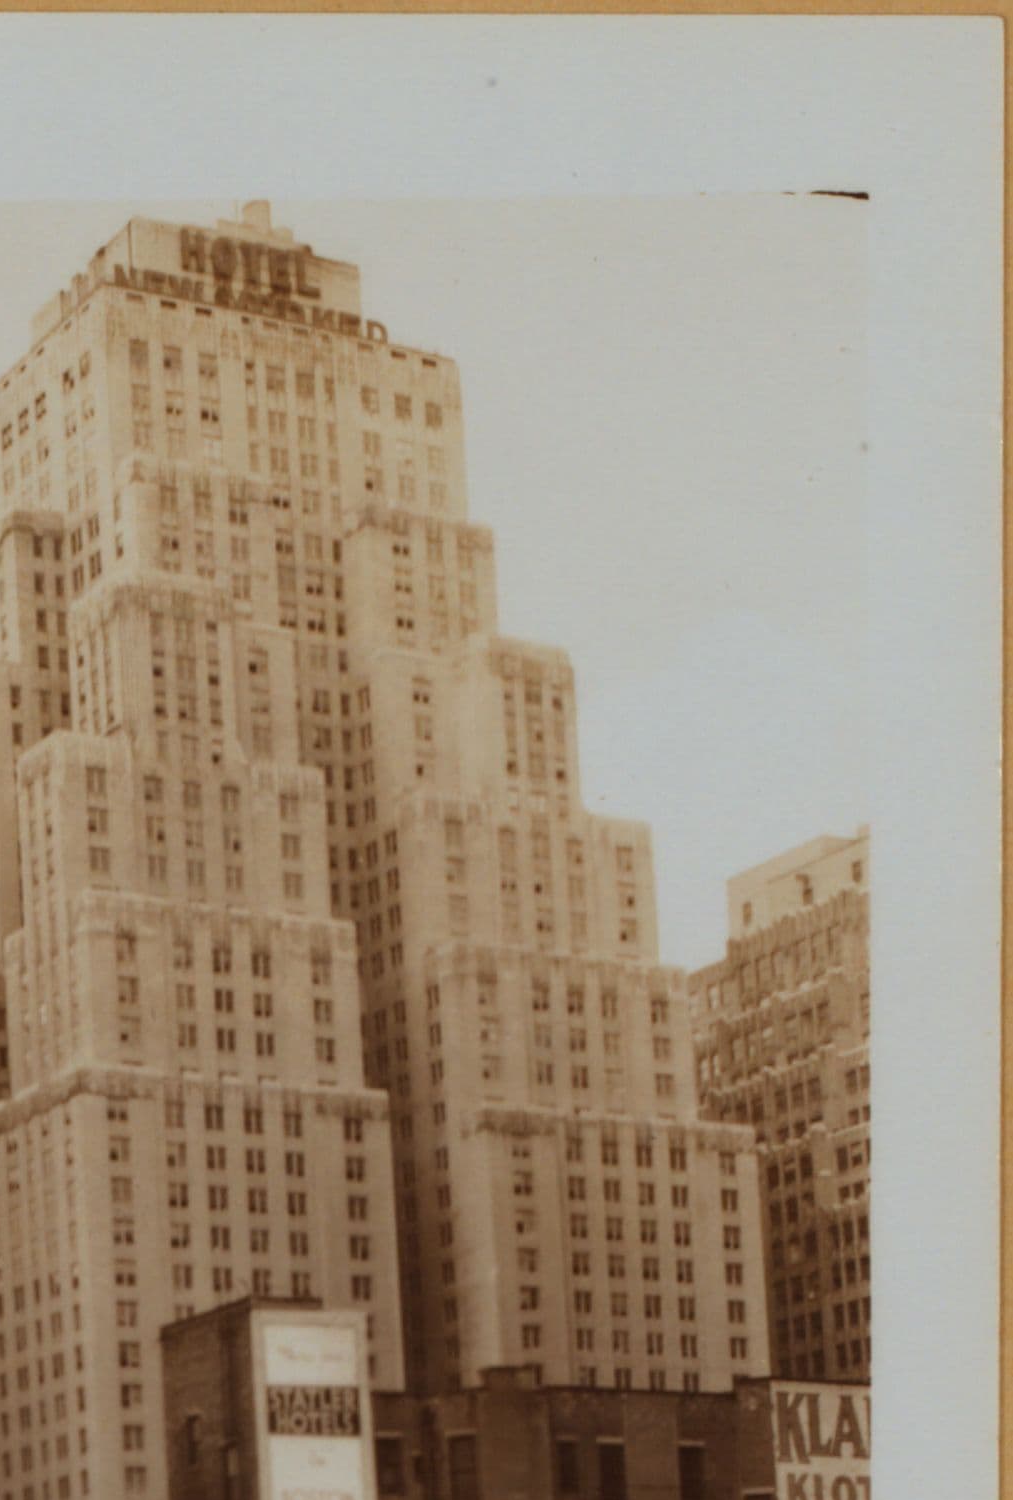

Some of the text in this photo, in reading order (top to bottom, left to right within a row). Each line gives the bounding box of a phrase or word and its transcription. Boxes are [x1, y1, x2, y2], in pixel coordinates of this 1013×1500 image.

[114, 264, 204, 302] NEW
[180, 227, 321, 299] HOTEL
[277, 1411, 353, 1434] HOTELS
[776, 1392, 871, 1464] KLA
